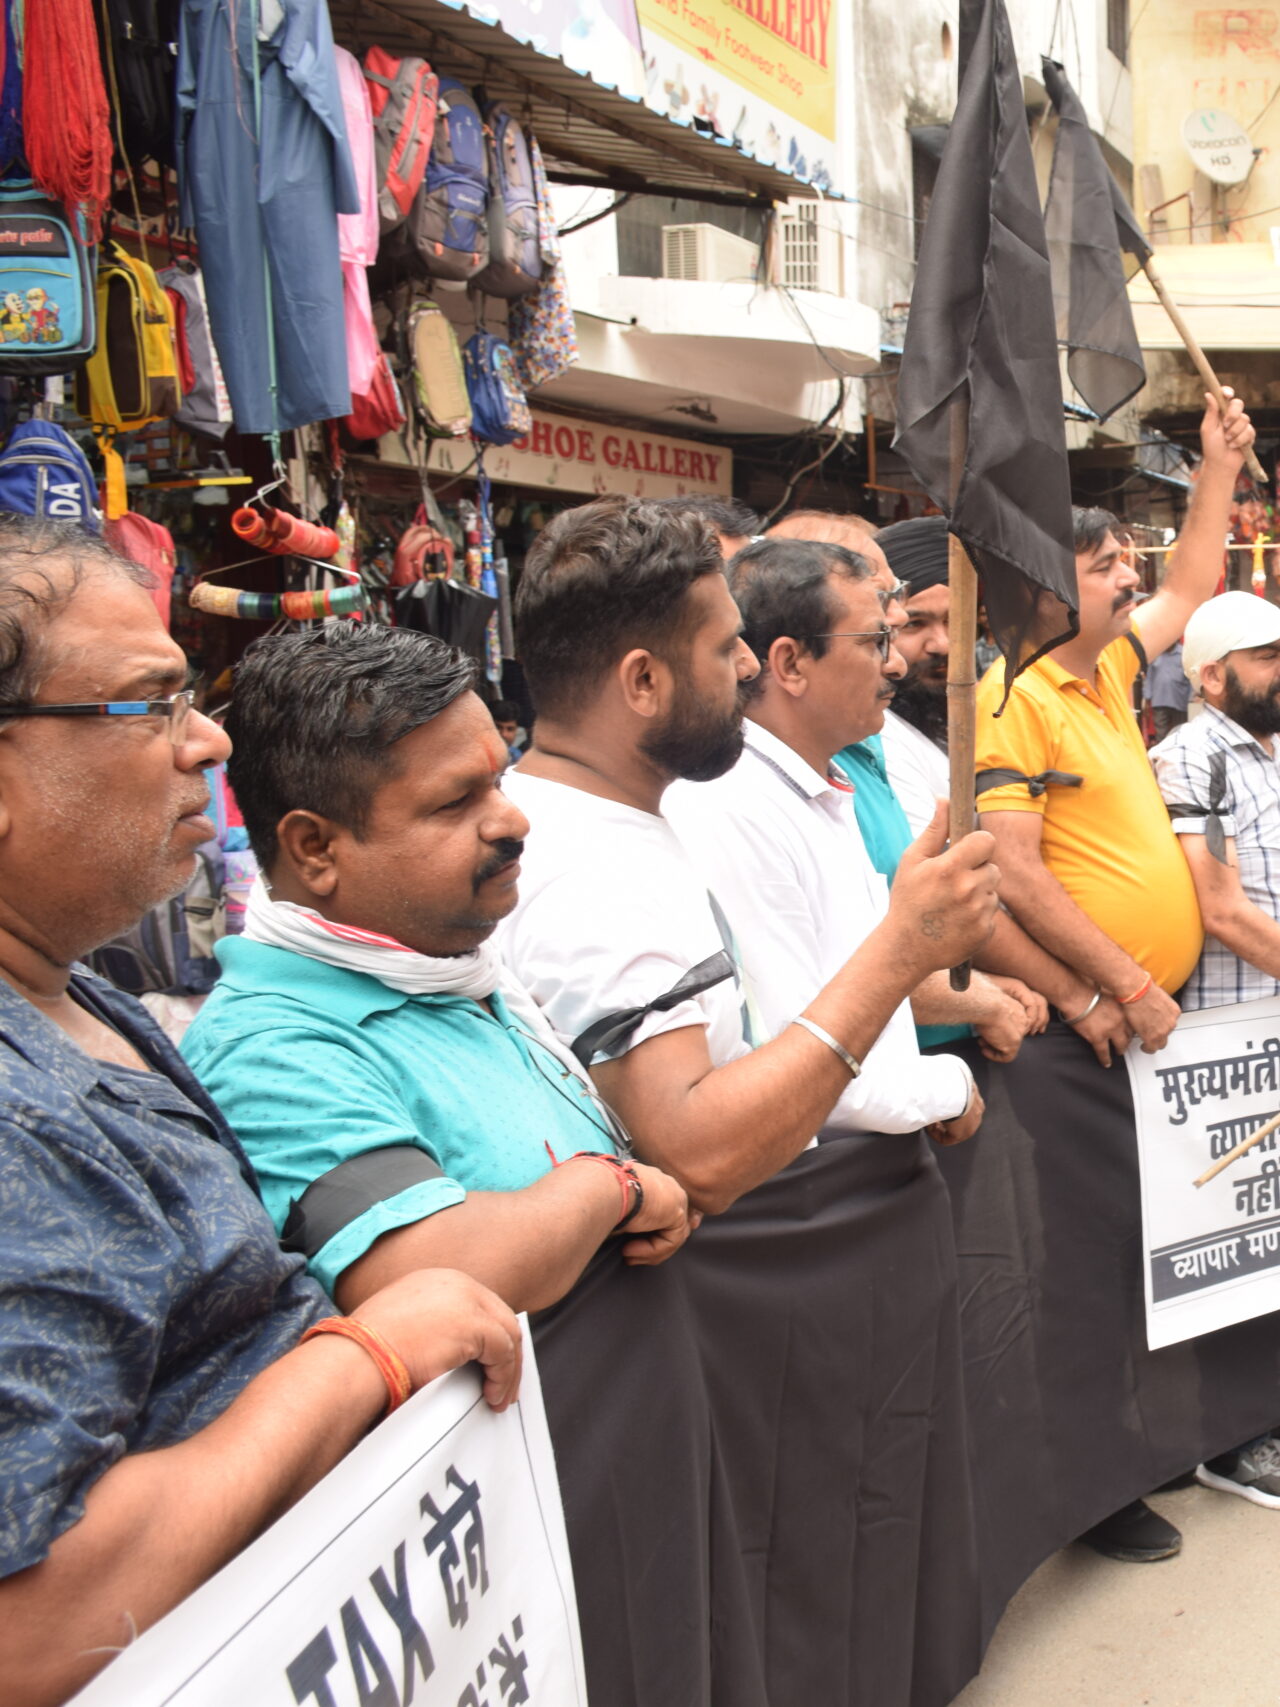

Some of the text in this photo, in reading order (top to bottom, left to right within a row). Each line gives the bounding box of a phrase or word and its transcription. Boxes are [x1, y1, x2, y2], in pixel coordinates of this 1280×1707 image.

[682, 1, 721, 47] Family
[725, 27, 776, 78] Footwear
[777, 63, 803, 97] Shop
[1210, 154, 1231, 166] HD
[602, 436, 722, 483] GALLERY
[1170, 1237, 1241, 1279] व्यापार
[286, 1540, 435, 1707] TAX
